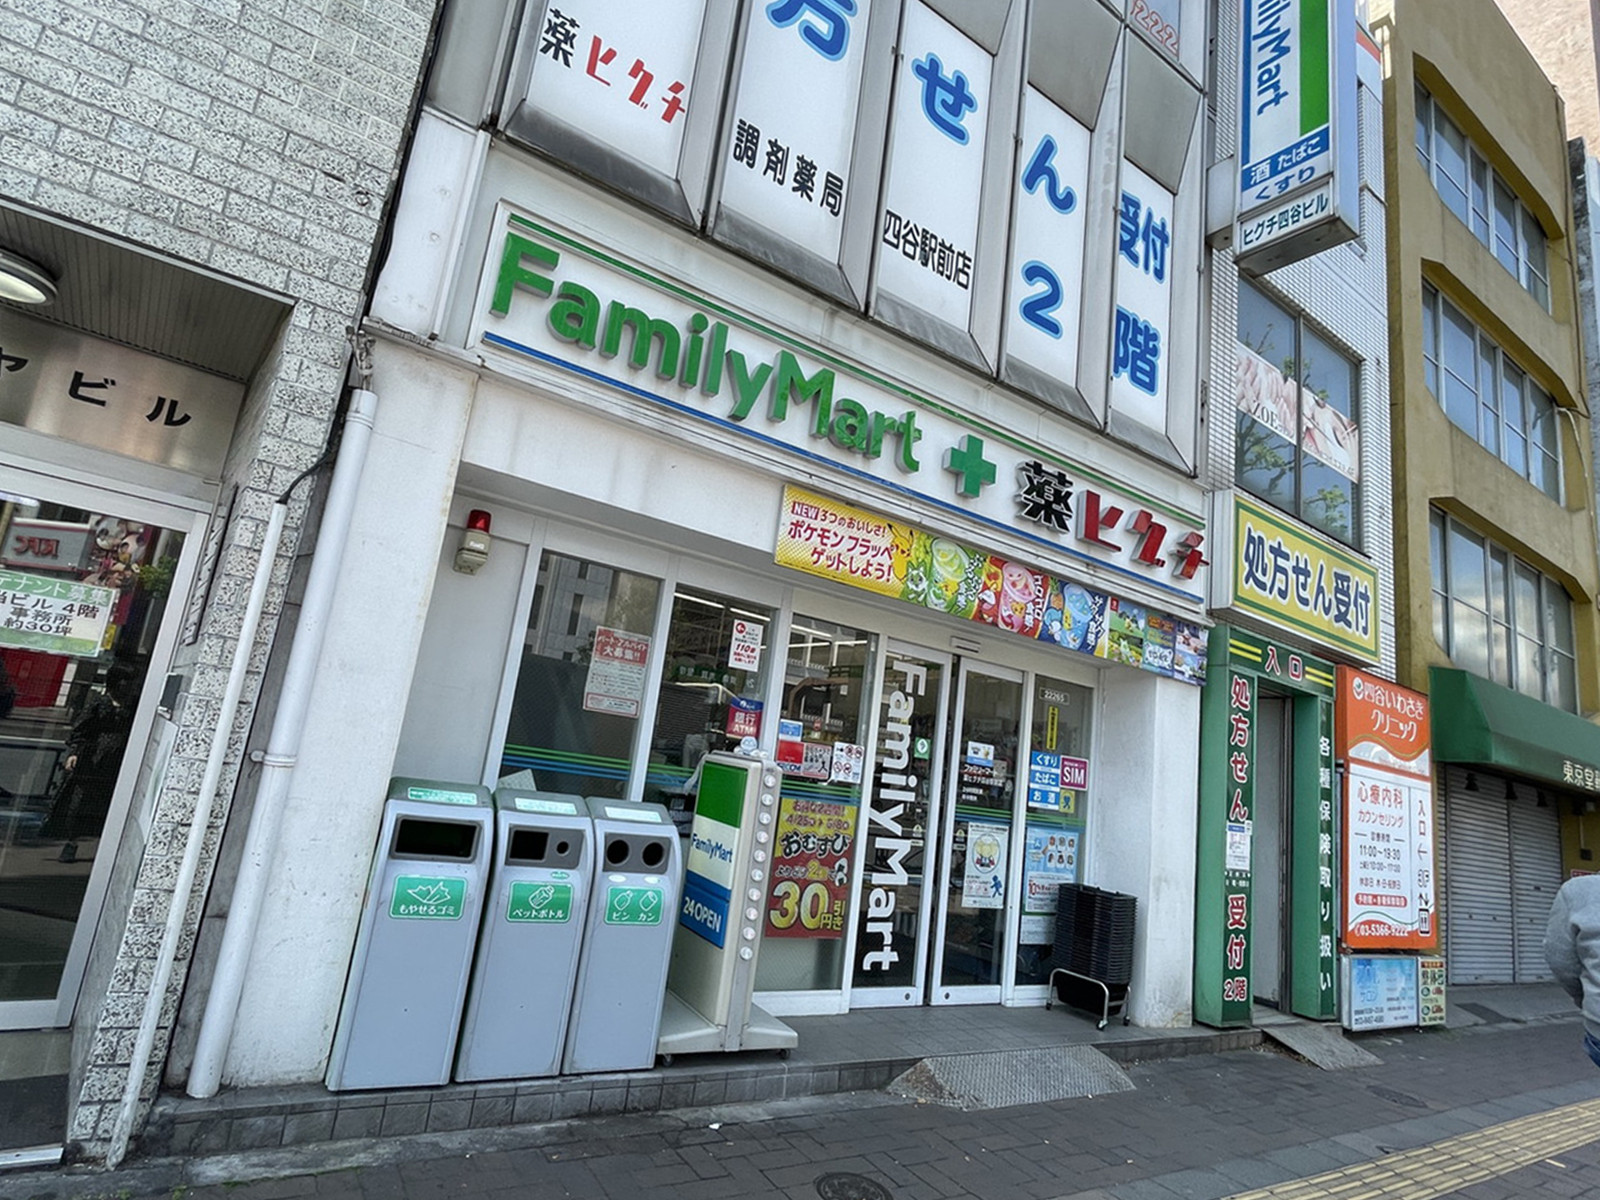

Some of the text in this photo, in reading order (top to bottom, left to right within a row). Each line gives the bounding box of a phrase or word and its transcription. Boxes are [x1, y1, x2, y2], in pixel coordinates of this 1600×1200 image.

[540, 7, 686, 124] 薬ヒグチ
[732, 119, 844, 217] 調剤薬局
[1250, 136, 1322, 184] 酒 たばこ
[1255, 165, 1316, 200] くすり
[1243, 193, 1328, 246] ヒグチ四谷ビル
[882, 209, 973, 291] 四谷駅前店
[489, 231, 1210, 580] FamilyMart 薬ヒグチ
[793, 503, 818, 519] NEW
[811, 548, 893, 583] ゲットしよう!
[1243, 525, 1371, 637] 処方せん受付
[3, 618, 73, 636] 約30坪
[10, 607, 73, 626] 事務所
[62, 603, 99, 619] 4階
[1265, 646, 1303, 681] 入口
[1371, 709, 1417, 742] クリニック
[1036, 754, 1058, 767] くすり
[1063, 767, 1084, 784] SIM
[1034, 773, 1056, 785] たばこ
[863, 660, 927, 970] FamilyMart
[692, 833, 734, 864] FamilyMart
[400, 904, 455, 916] もやせるゴミ
[512, 909, 565, 919] ペットボトル
[1227, 893, 1247, 970] 受付
[1224, 977, 1247, 1001] 2階
